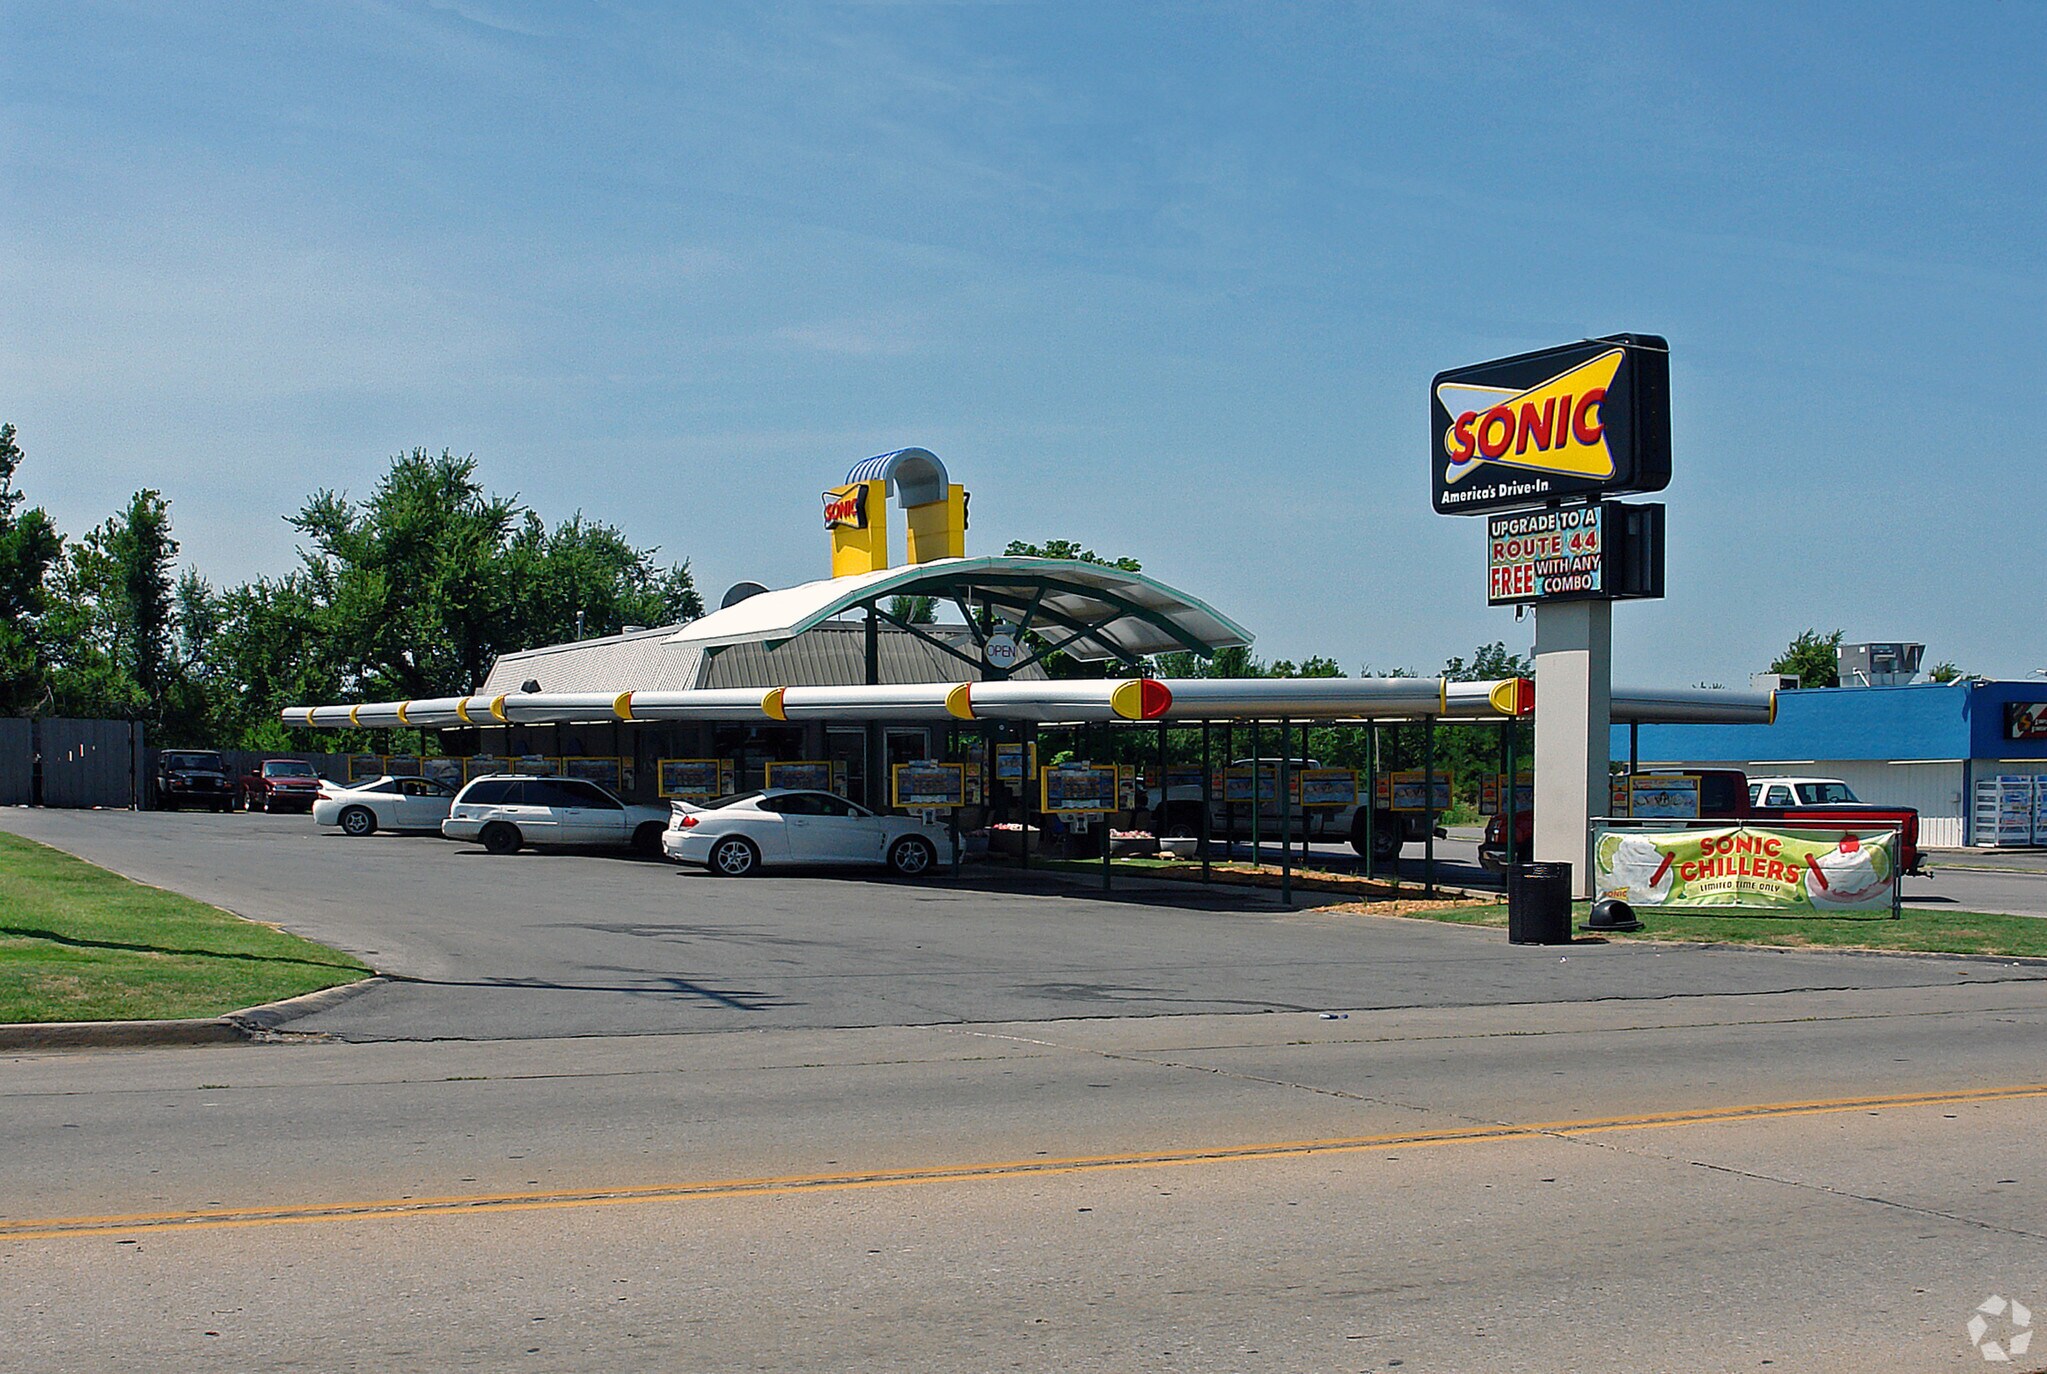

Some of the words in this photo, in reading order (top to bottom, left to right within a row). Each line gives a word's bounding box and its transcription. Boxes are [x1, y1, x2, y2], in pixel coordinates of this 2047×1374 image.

[1451, 387, 1607, 465] SONIC
[1441, 485, 1496, 504] America's
[825, 498, 858, 520] SONIC
[1491, 514, 1556, 537] UPGRADE
[1560, 511, 1580, 528] TO
[1584, 509, 1596, 526] A
[1493, 536, 1562, 560] ROUTE
[1570, 531, 1597, 550] 44
[1536, 559, 1569, 575] WITH
[1572, 554, 1600, 572] ANY
[1491, 564, 1534, 597] FREE
[1544, 574, 1592, 593] COMBO
[986, 644, 1016, 658] OPEN
[1700, 835, 1782, 857] SONIC
[1680, 857, 1801, 884] CHILLERS
[1700, 881, 1732, 892] LIMITED
[1735, 881, 1755, 890] TIME
[1759, 882, 1780, 893] ONLY
